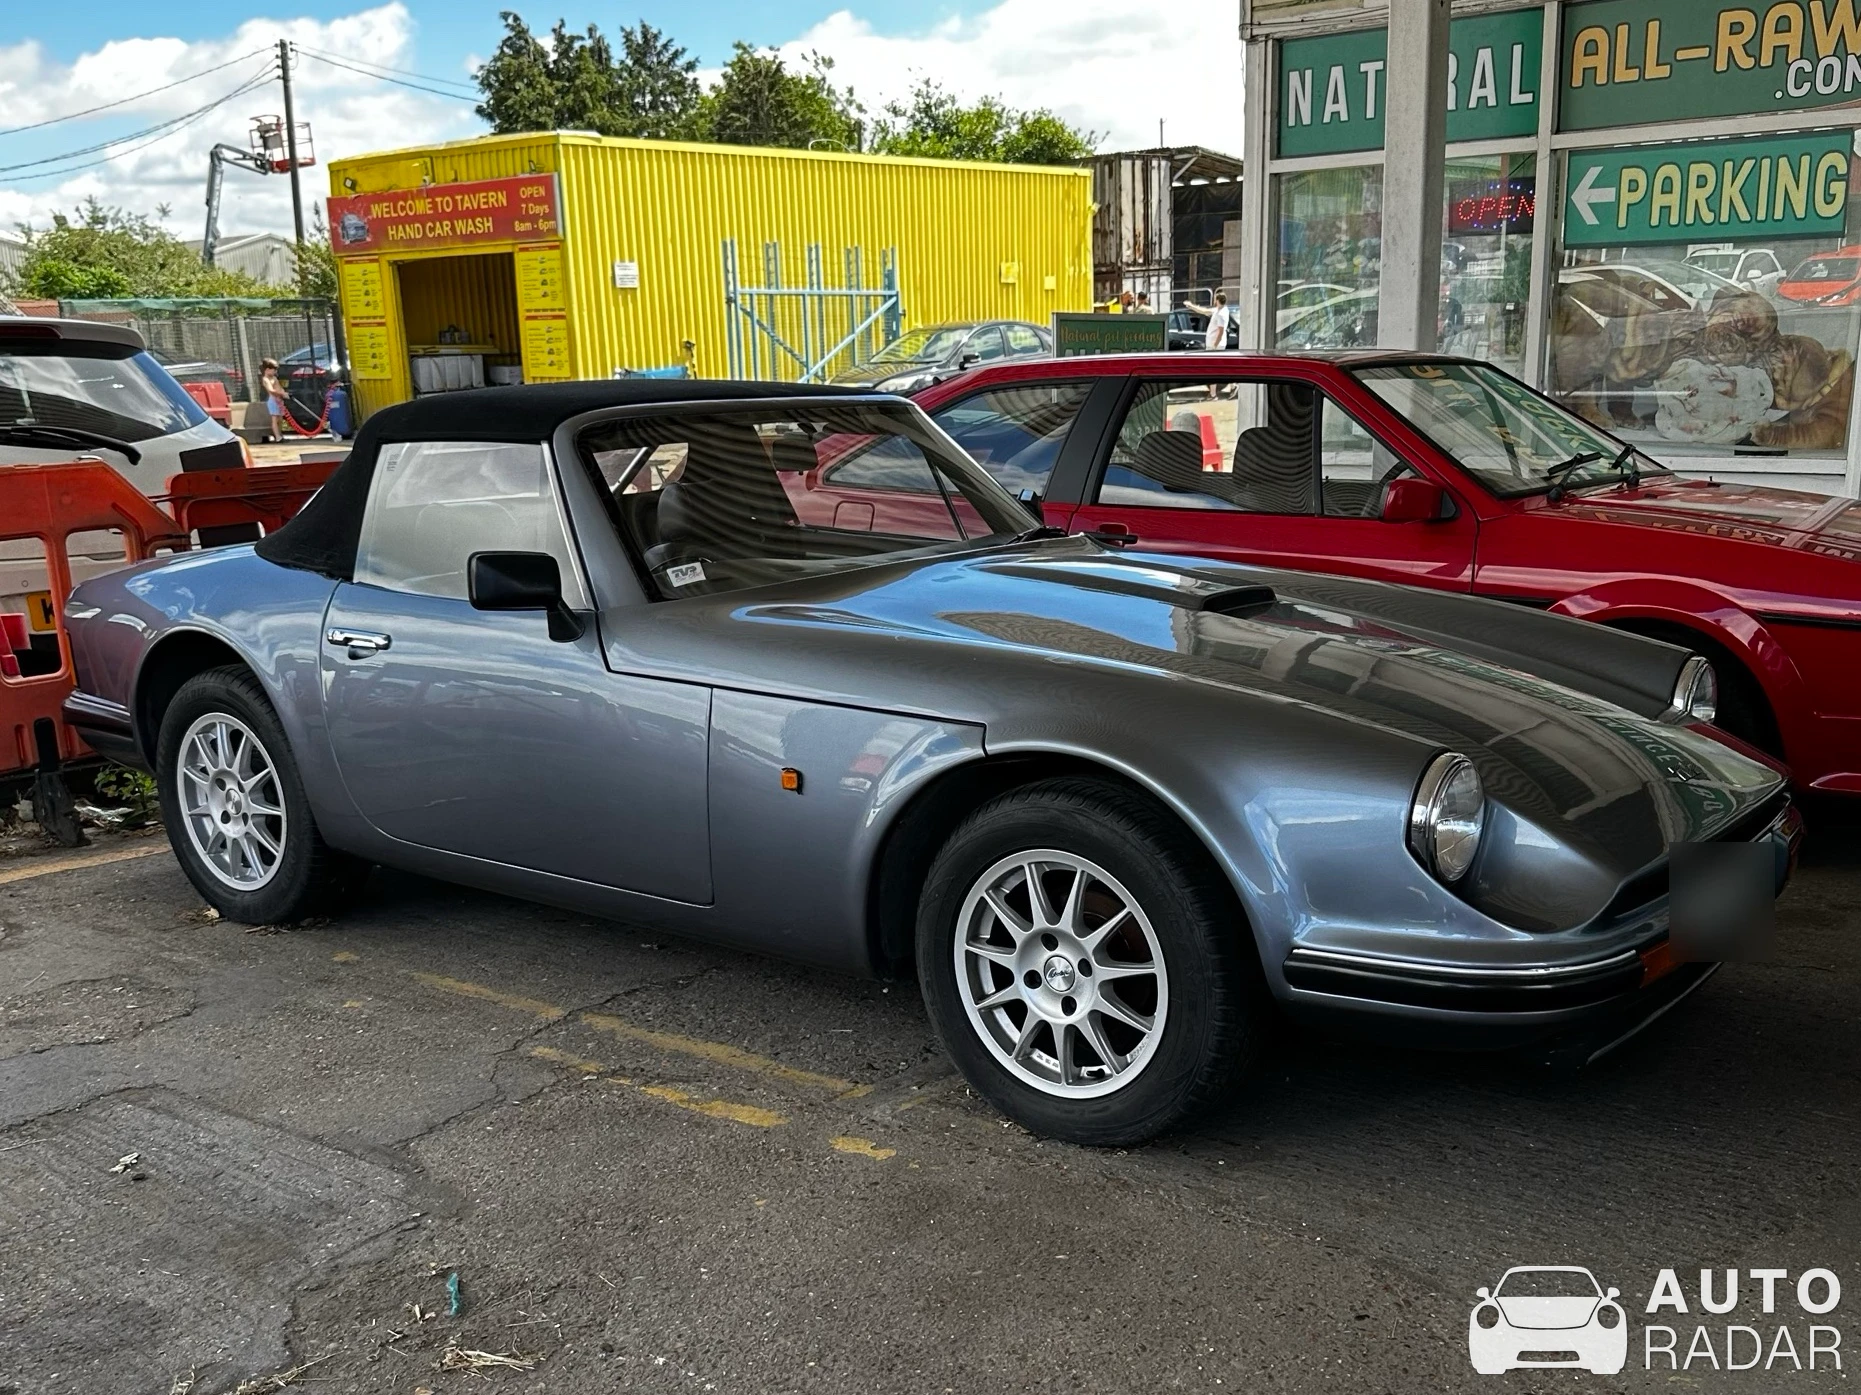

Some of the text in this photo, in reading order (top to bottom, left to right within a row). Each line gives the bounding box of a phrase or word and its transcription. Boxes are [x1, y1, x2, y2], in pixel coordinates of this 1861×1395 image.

[1287, 43, 1535, 128] NATAL
[520, 186, 546, 199] OPEN
[1616, 150, 1849, 229] PARKING
[370, 191, 508, 218] WELCOME TO TAVERN
[521, 203, 550, 217] 7 Days
[1458, 195, 1536, 221] OPEN
[388, 217, 494, 241] HAND CAR WASH
[514, 221, 532, 232] 8am
[538, 219, 557, 233] 6pm
[1061, 327, 1099, 343] Natural
